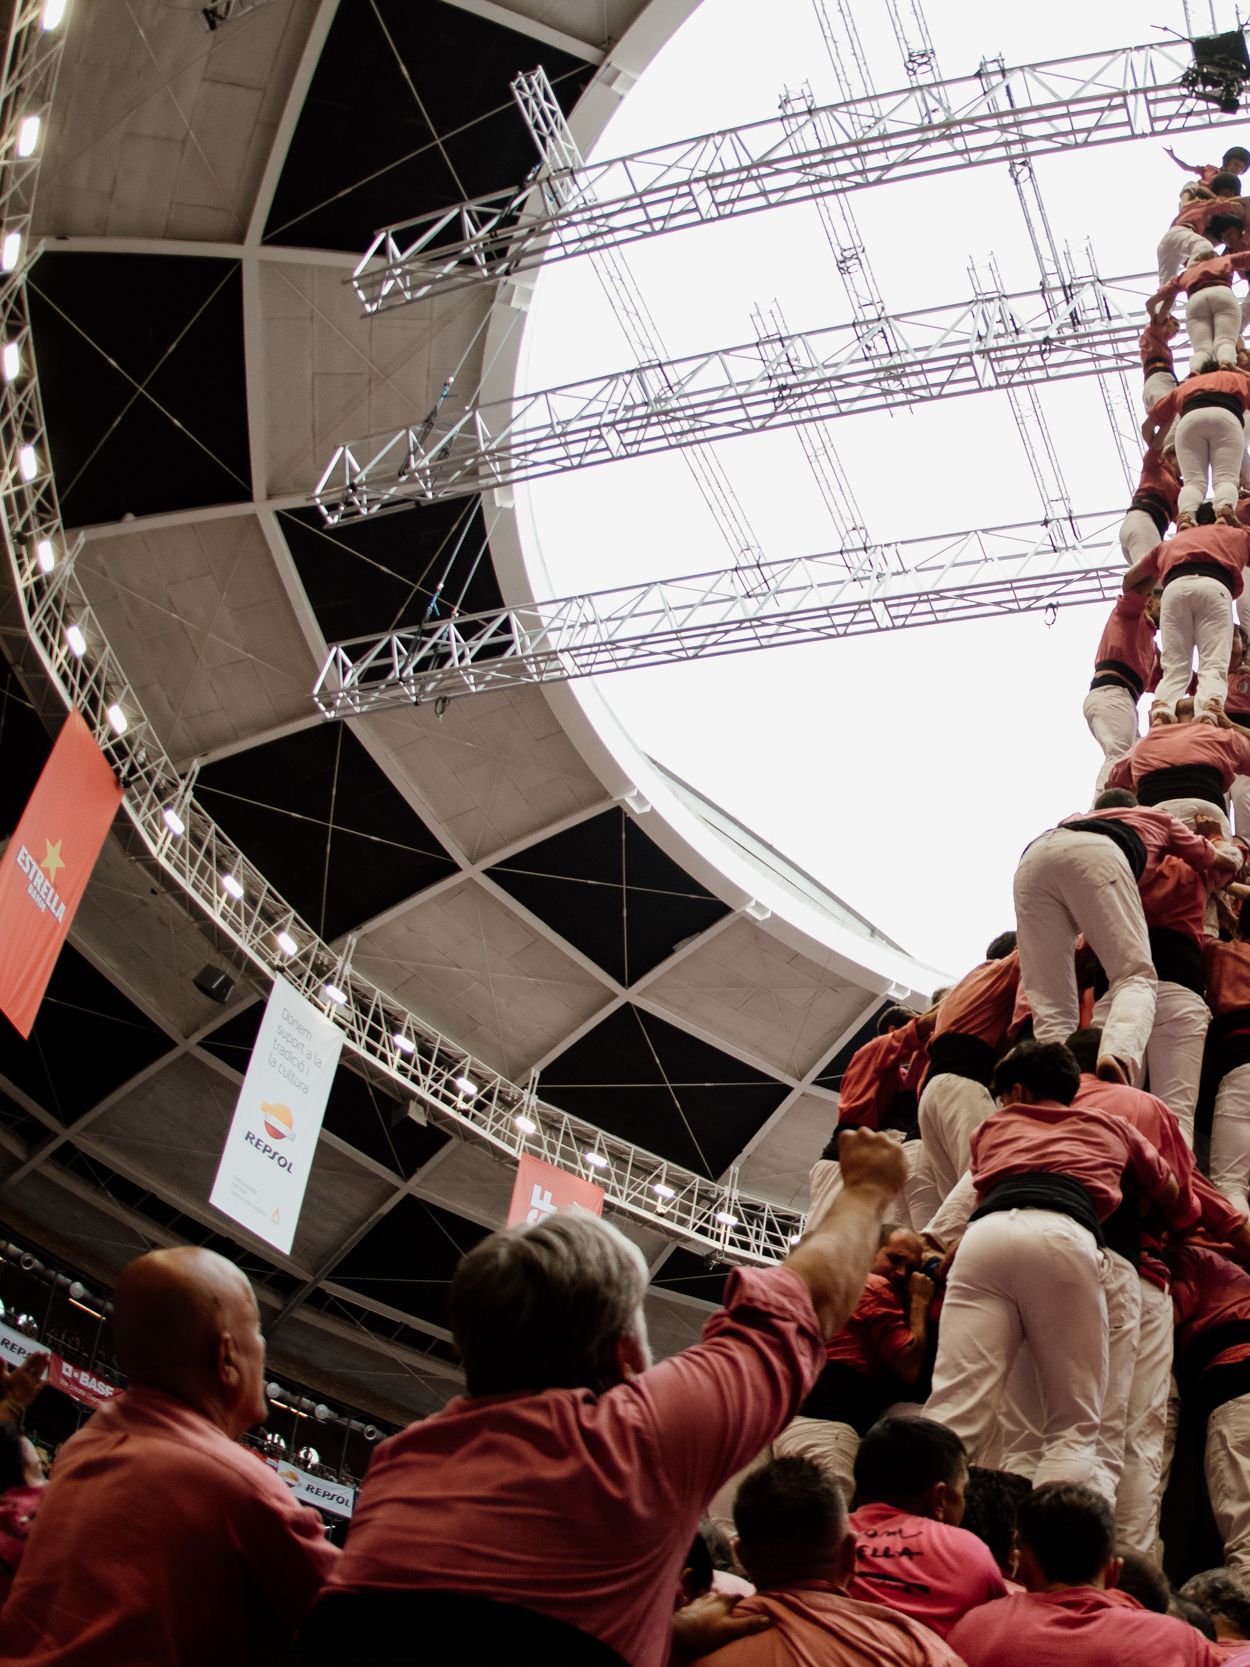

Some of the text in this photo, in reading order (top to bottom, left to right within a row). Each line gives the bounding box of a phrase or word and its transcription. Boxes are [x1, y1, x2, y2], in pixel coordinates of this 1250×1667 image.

[16, 844, 66, 924] ESTRELLA
[276, 1024, 304, 1055] suport
[281, 1007, 313, 1042] Donem
[273, 1038, 305, 1073] tradició
[268, 1052, 310, 1095] la cultura
[244, 1129, 295, 1174] REPSOL
[79, 1371, 114, 1397] BASF
[305, 1483, 351, 1507] REPSOL
